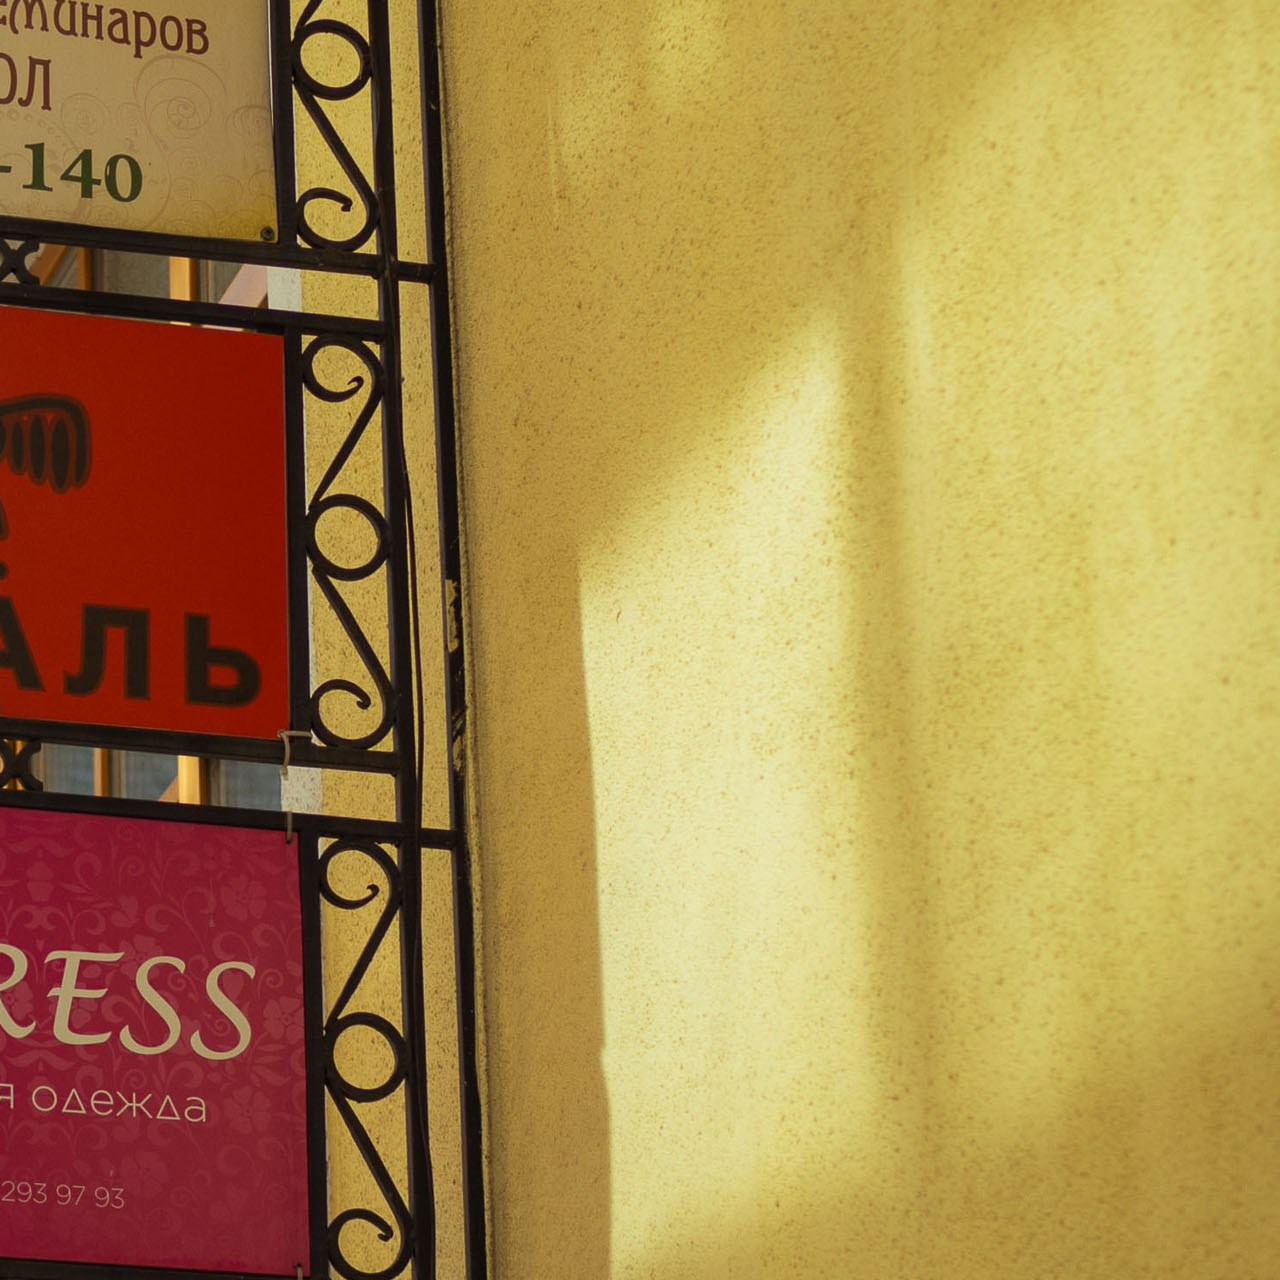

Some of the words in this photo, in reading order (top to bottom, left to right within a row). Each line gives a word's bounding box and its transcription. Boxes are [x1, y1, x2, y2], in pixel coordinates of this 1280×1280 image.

[32, 1084, 207, 1123] одежда
[1, 1180, 47, 1204] 293
[55, 1184, 86, 1206] 97
[94, 1186, 125, 1209] 93
